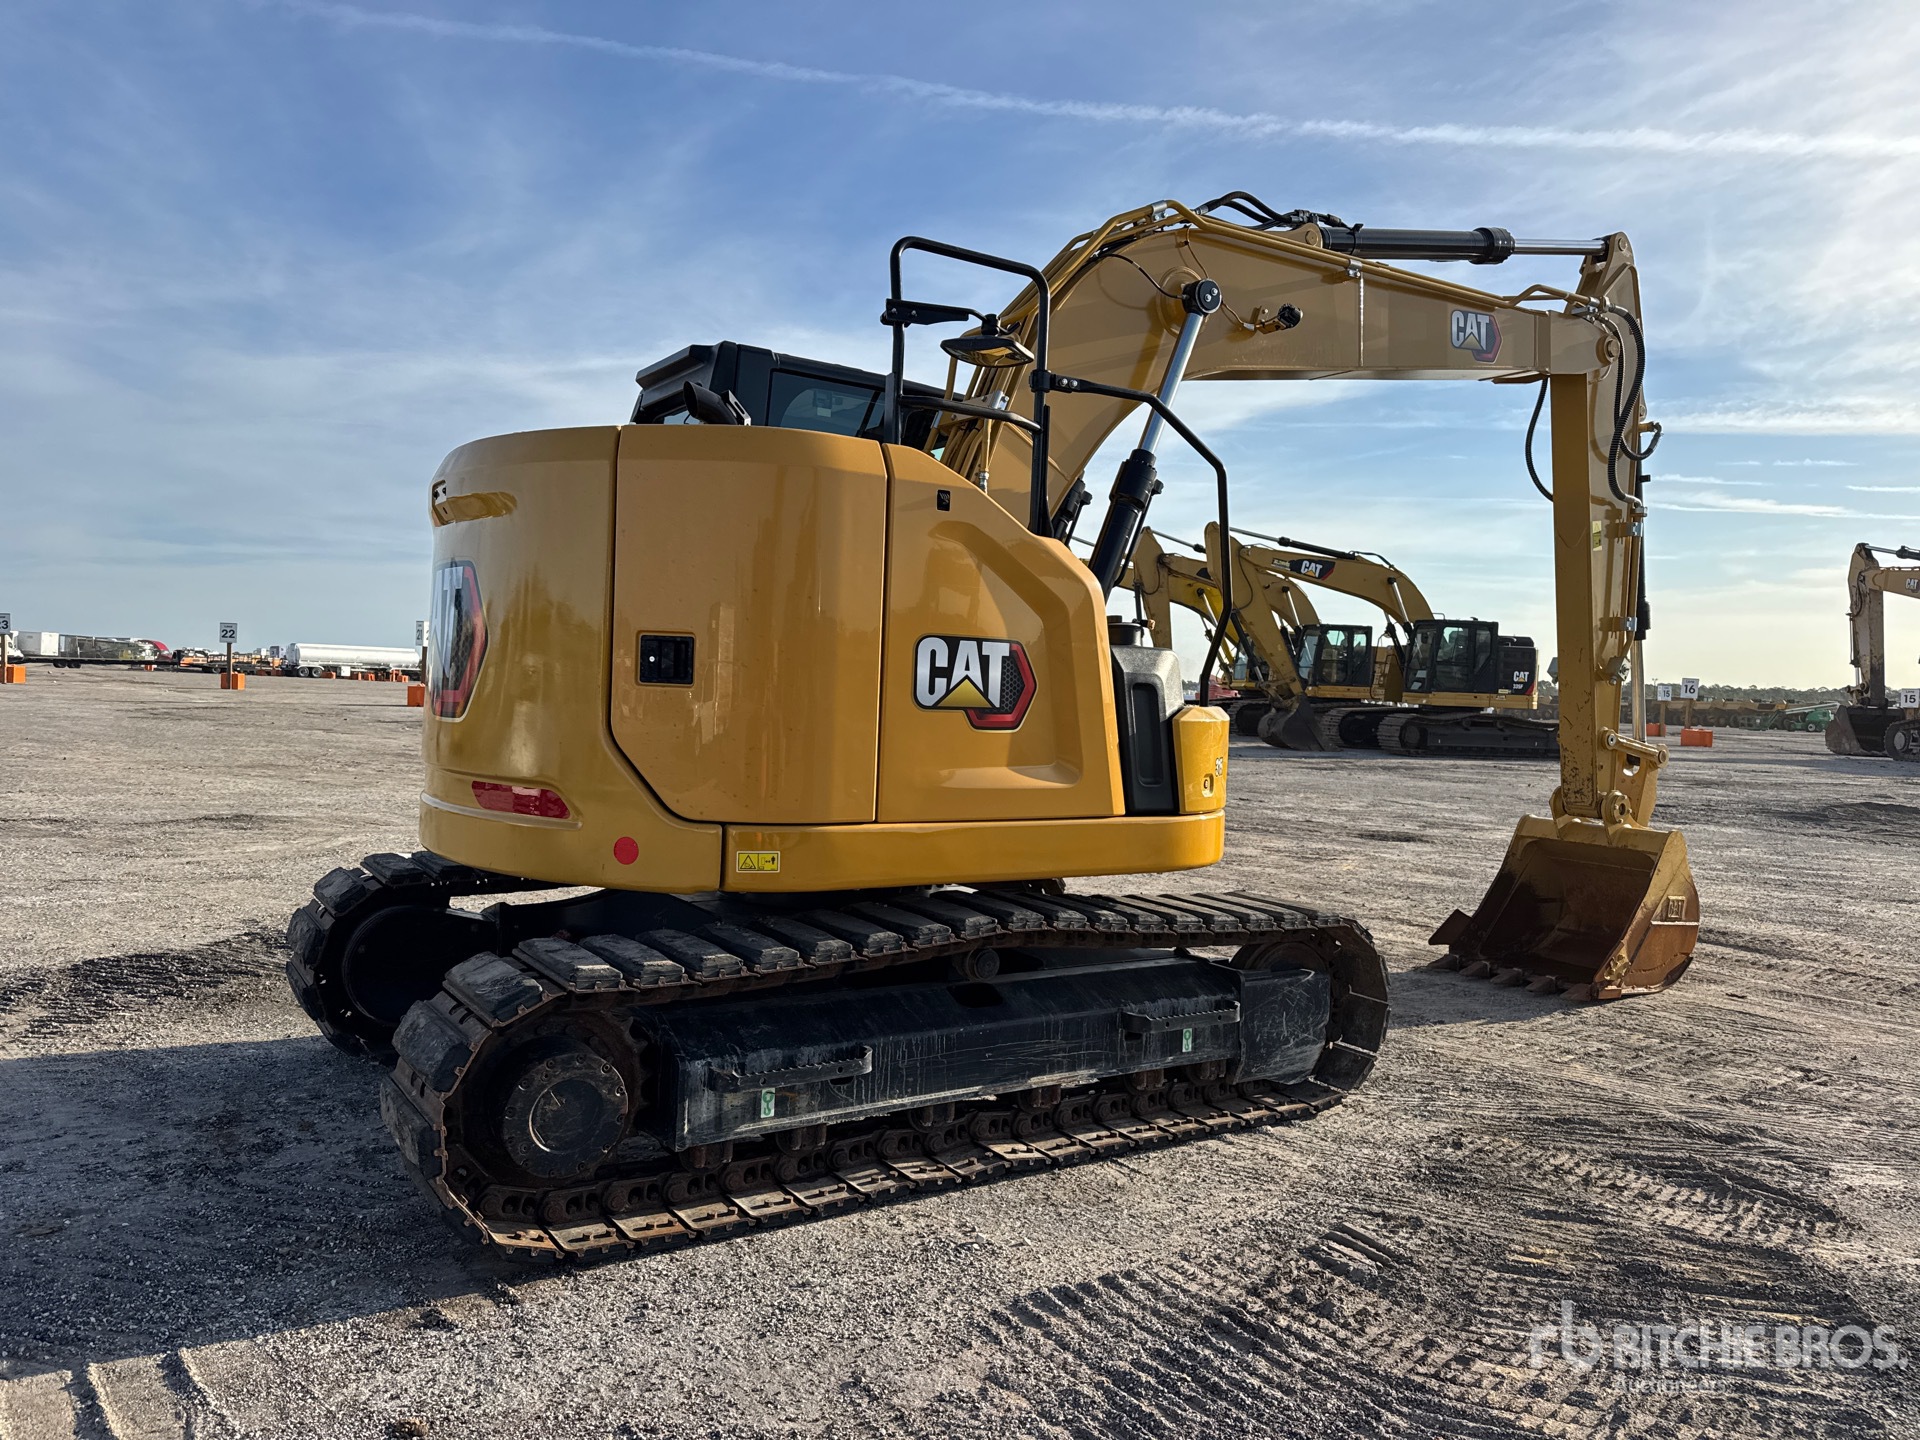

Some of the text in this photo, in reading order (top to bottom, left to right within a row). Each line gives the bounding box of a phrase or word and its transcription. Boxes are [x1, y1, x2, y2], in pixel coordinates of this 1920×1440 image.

[1451, 310, 1490, 350] CAT
[1300, 560, 1323, 578] CAT
[1905, 578, 1919, 590] CAT
[0, 620, 9, 630] 3
[221, 629, 236, 639] 22
[916, 637, 1010, 708] CAT
[1513, 671, 1530, 683] CAT
[1663, 690, 1671, 698] 15
[1684, 684, 1696, 695] 16
[1904, 694, 1917, 704] 15
